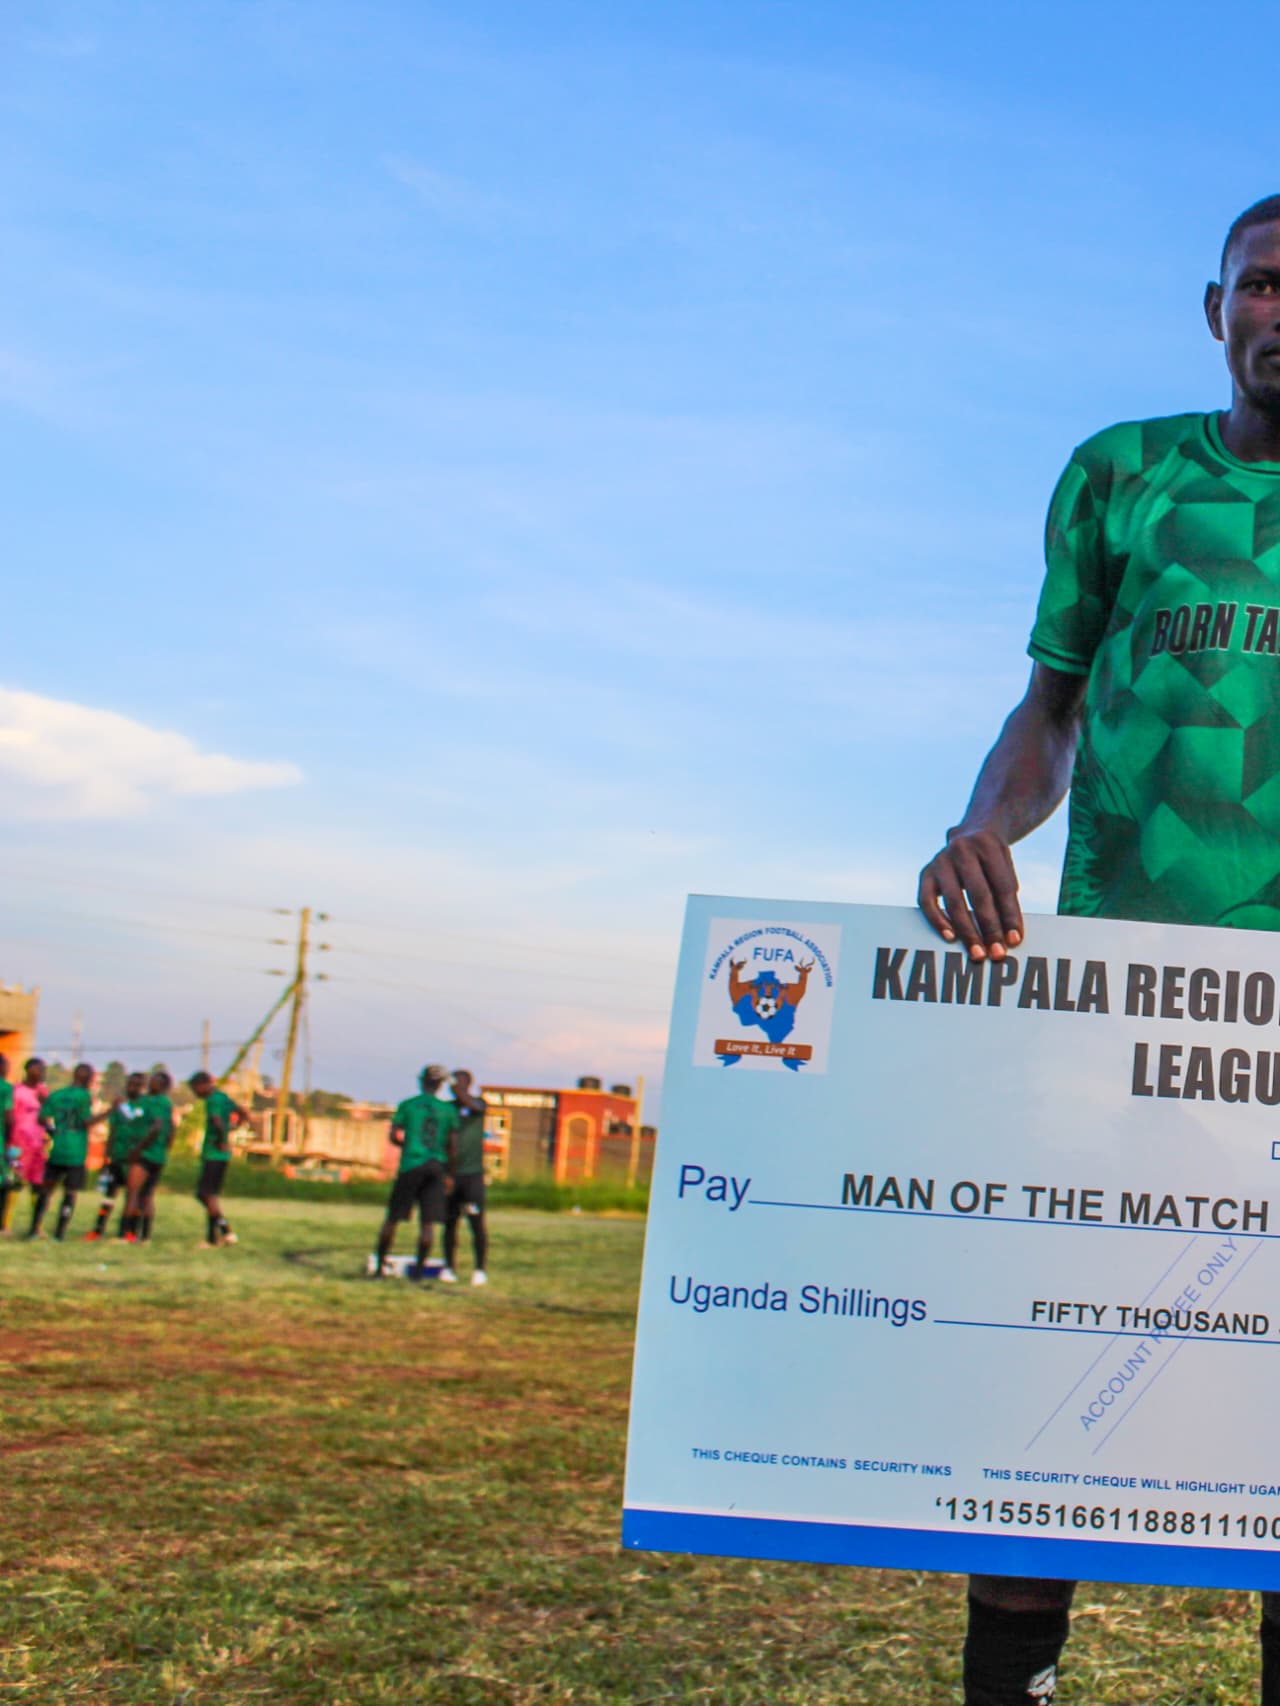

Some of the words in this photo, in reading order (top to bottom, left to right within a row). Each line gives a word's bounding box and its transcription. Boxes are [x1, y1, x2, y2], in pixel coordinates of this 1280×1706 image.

[1148, 601, 1239, 659] BORN
[710, 945, 734, 980] KAMPALA
[734, 929, 763, 946] REGION
[765, 927, 803, 942] FOOTBALL
[805, 939, 832, 987] ASSOCIATION
[753, 947, 795, 963] FUFA
[872, 947, 1110, 1013] KAMPALA
[726, 1042, 749, 1053] Love
[765, 1044, 786, 1054] Live
[678, 1164, 751, 1212] Pay
[841, 1173, 935, 1210] MAN
[950, 1181, 1007, 1214] OF
[1022, 1185, 1104, 1222] THE
[1120, 1192, 1269, 1232] MATCH
[670, 1275, 788, 1313] Uganda
[799, 1285, 927, 1326] Shillings
[1032, 1301, 1108, 1325] FIFTY
[1117, 1306, 1269, 1335] THOUSAND
[1080, 1341, 1152, 1431] ACCOUNT
[1197, 1237, 1239, 1286] ONLY
[692, 1448, 720, 1461] THIS
[724, 1450, 777, 1465] CHEQUE
[782, 1455, 847, 1469] CONTAINS
[854, 1460, 918, 1475] SECURITY
[922, 1464, 952, 1477] INKS
[982, 1468, 1011, 1481] THIS
[1015, 1470, 1079, 1485] SECURITY
[1083, 1474, 1137, 1489] CHEQUE
[1141, 1478, 1171, 1490] WILL
[1175, 1480, 1245, 1495] HIGHLIGHT
